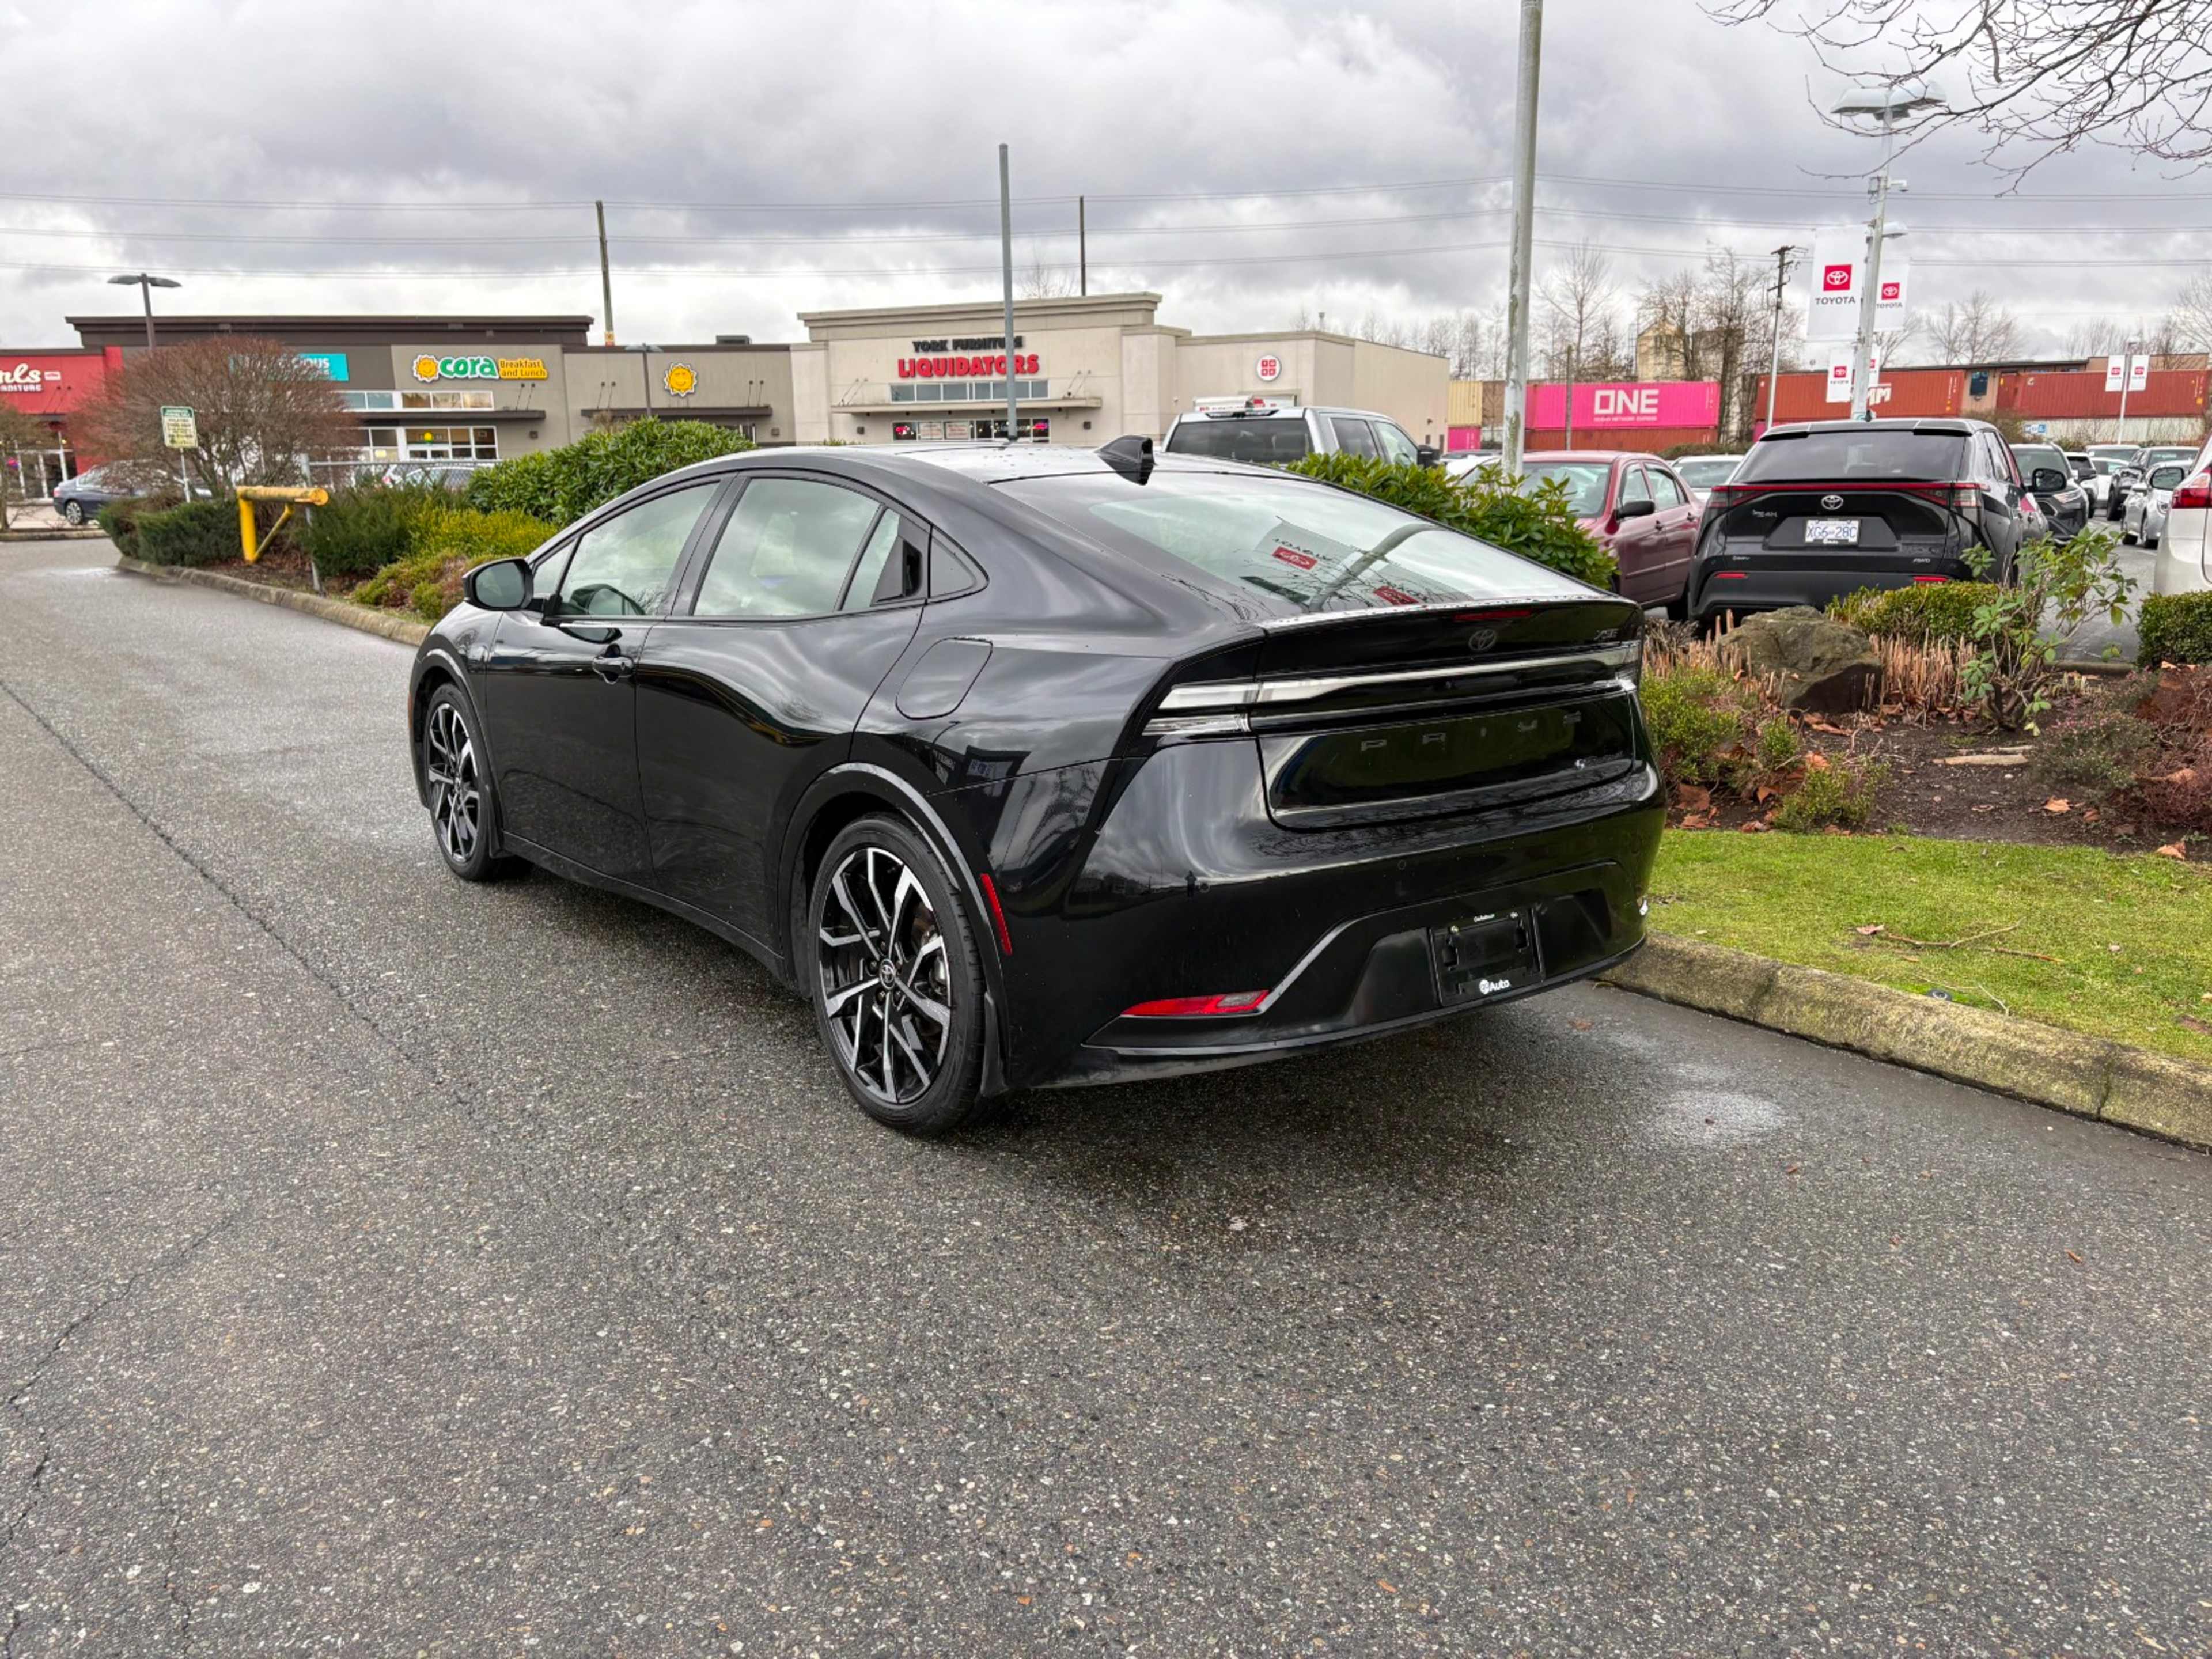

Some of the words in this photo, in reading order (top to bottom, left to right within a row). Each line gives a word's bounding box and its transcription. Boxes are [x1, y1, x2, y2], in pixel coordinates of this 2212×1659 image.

[1815, 297, 1856, 305] TOYOTA
[912, 340, 949, 352] YORK
[440, 358, 497, 377] cora
[521, 369, 546, 377] Lunch
[898, 354, 1040, 378] LIQUIDATORS
[1594, 389, 1659, 414] ONE
